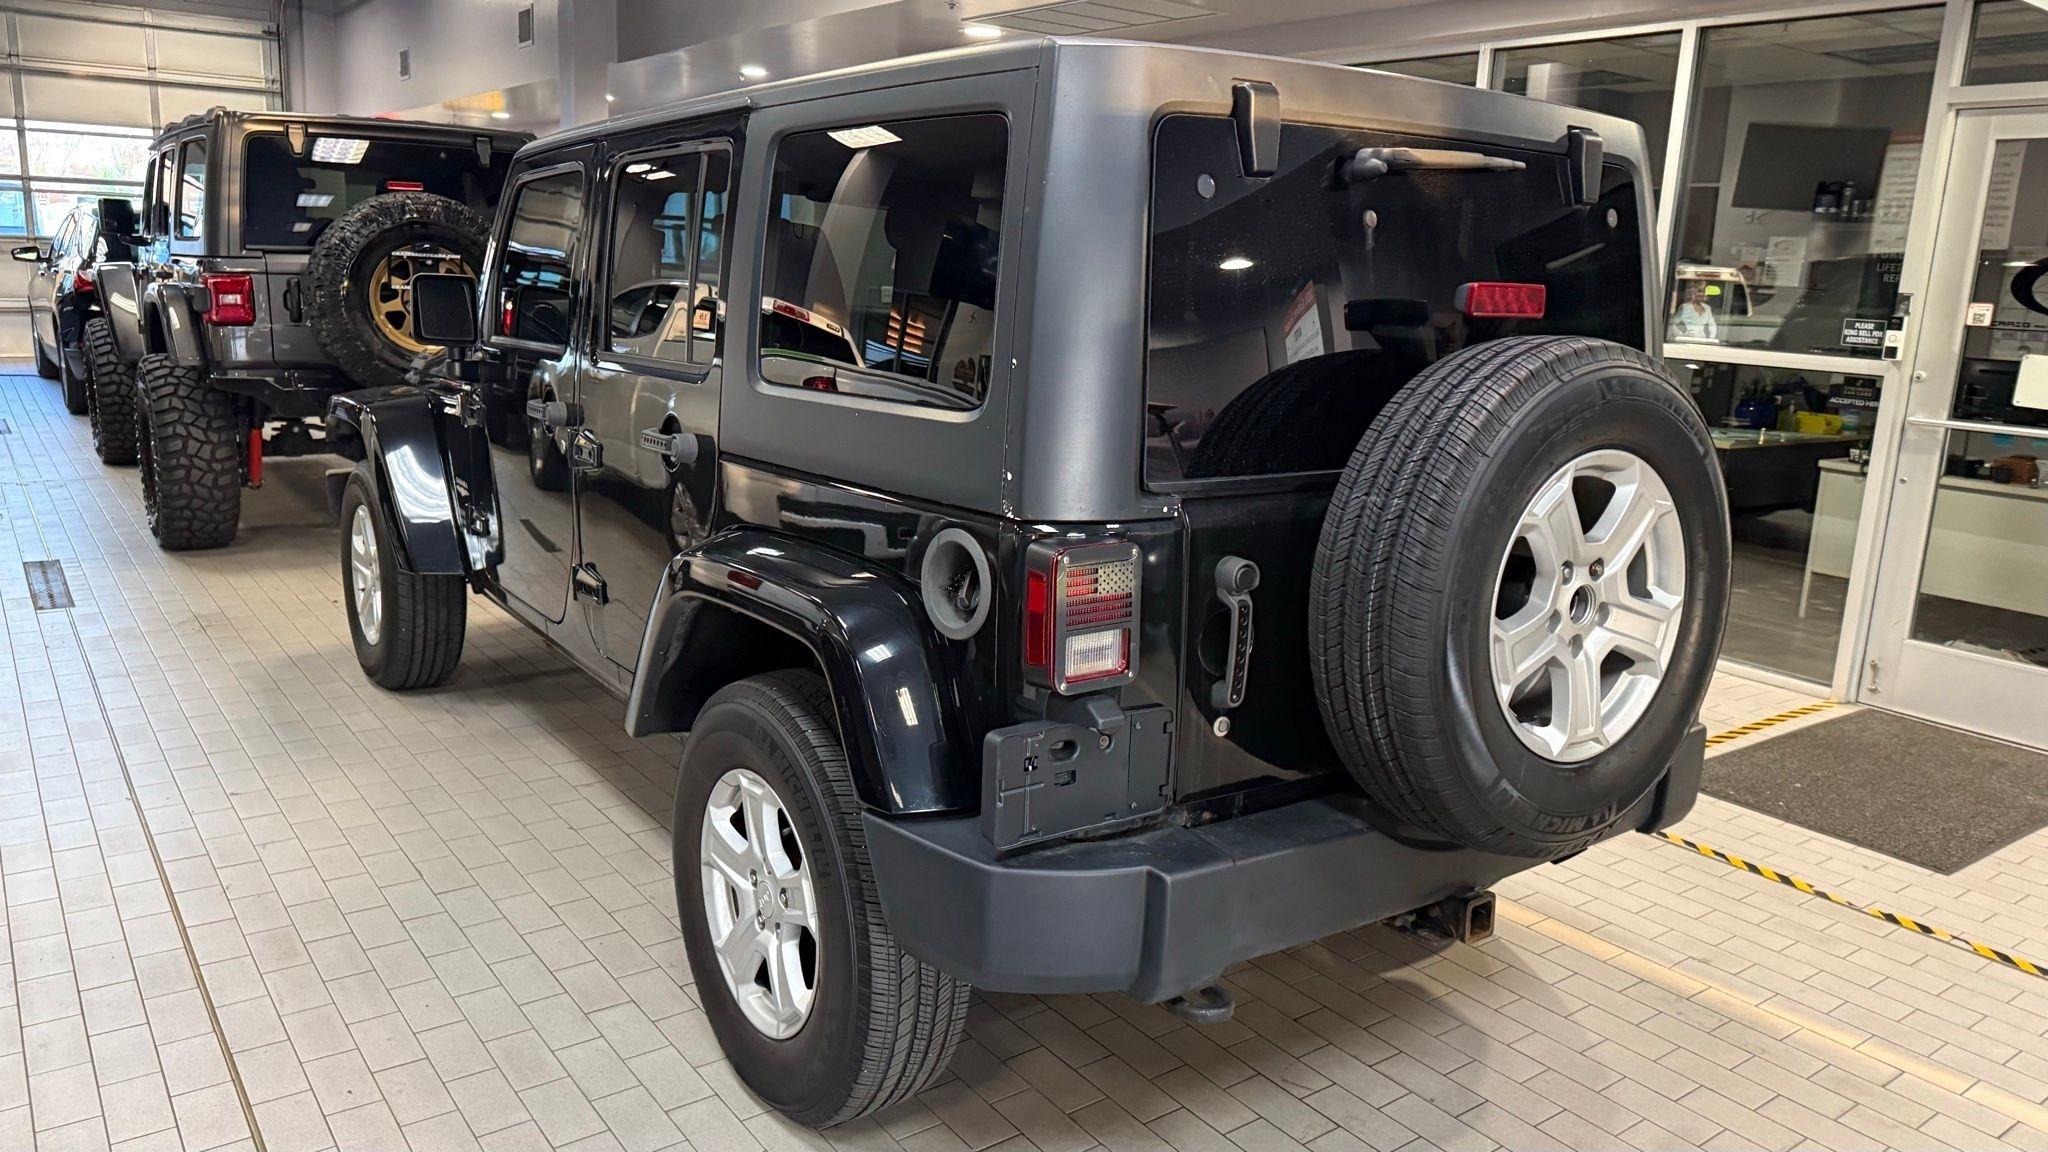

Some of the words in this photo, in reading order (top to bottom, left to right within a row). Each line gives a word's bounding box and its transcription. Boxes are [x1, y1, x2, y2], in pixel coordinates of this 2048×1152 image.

[1858, 329, 1871, 337] BELL
[1872, 330, 1883, 338] FOR
[1845, 336, 1879, 345] ASSISTANCE
[1829, 396, 1865, 406] ACCEPTED
